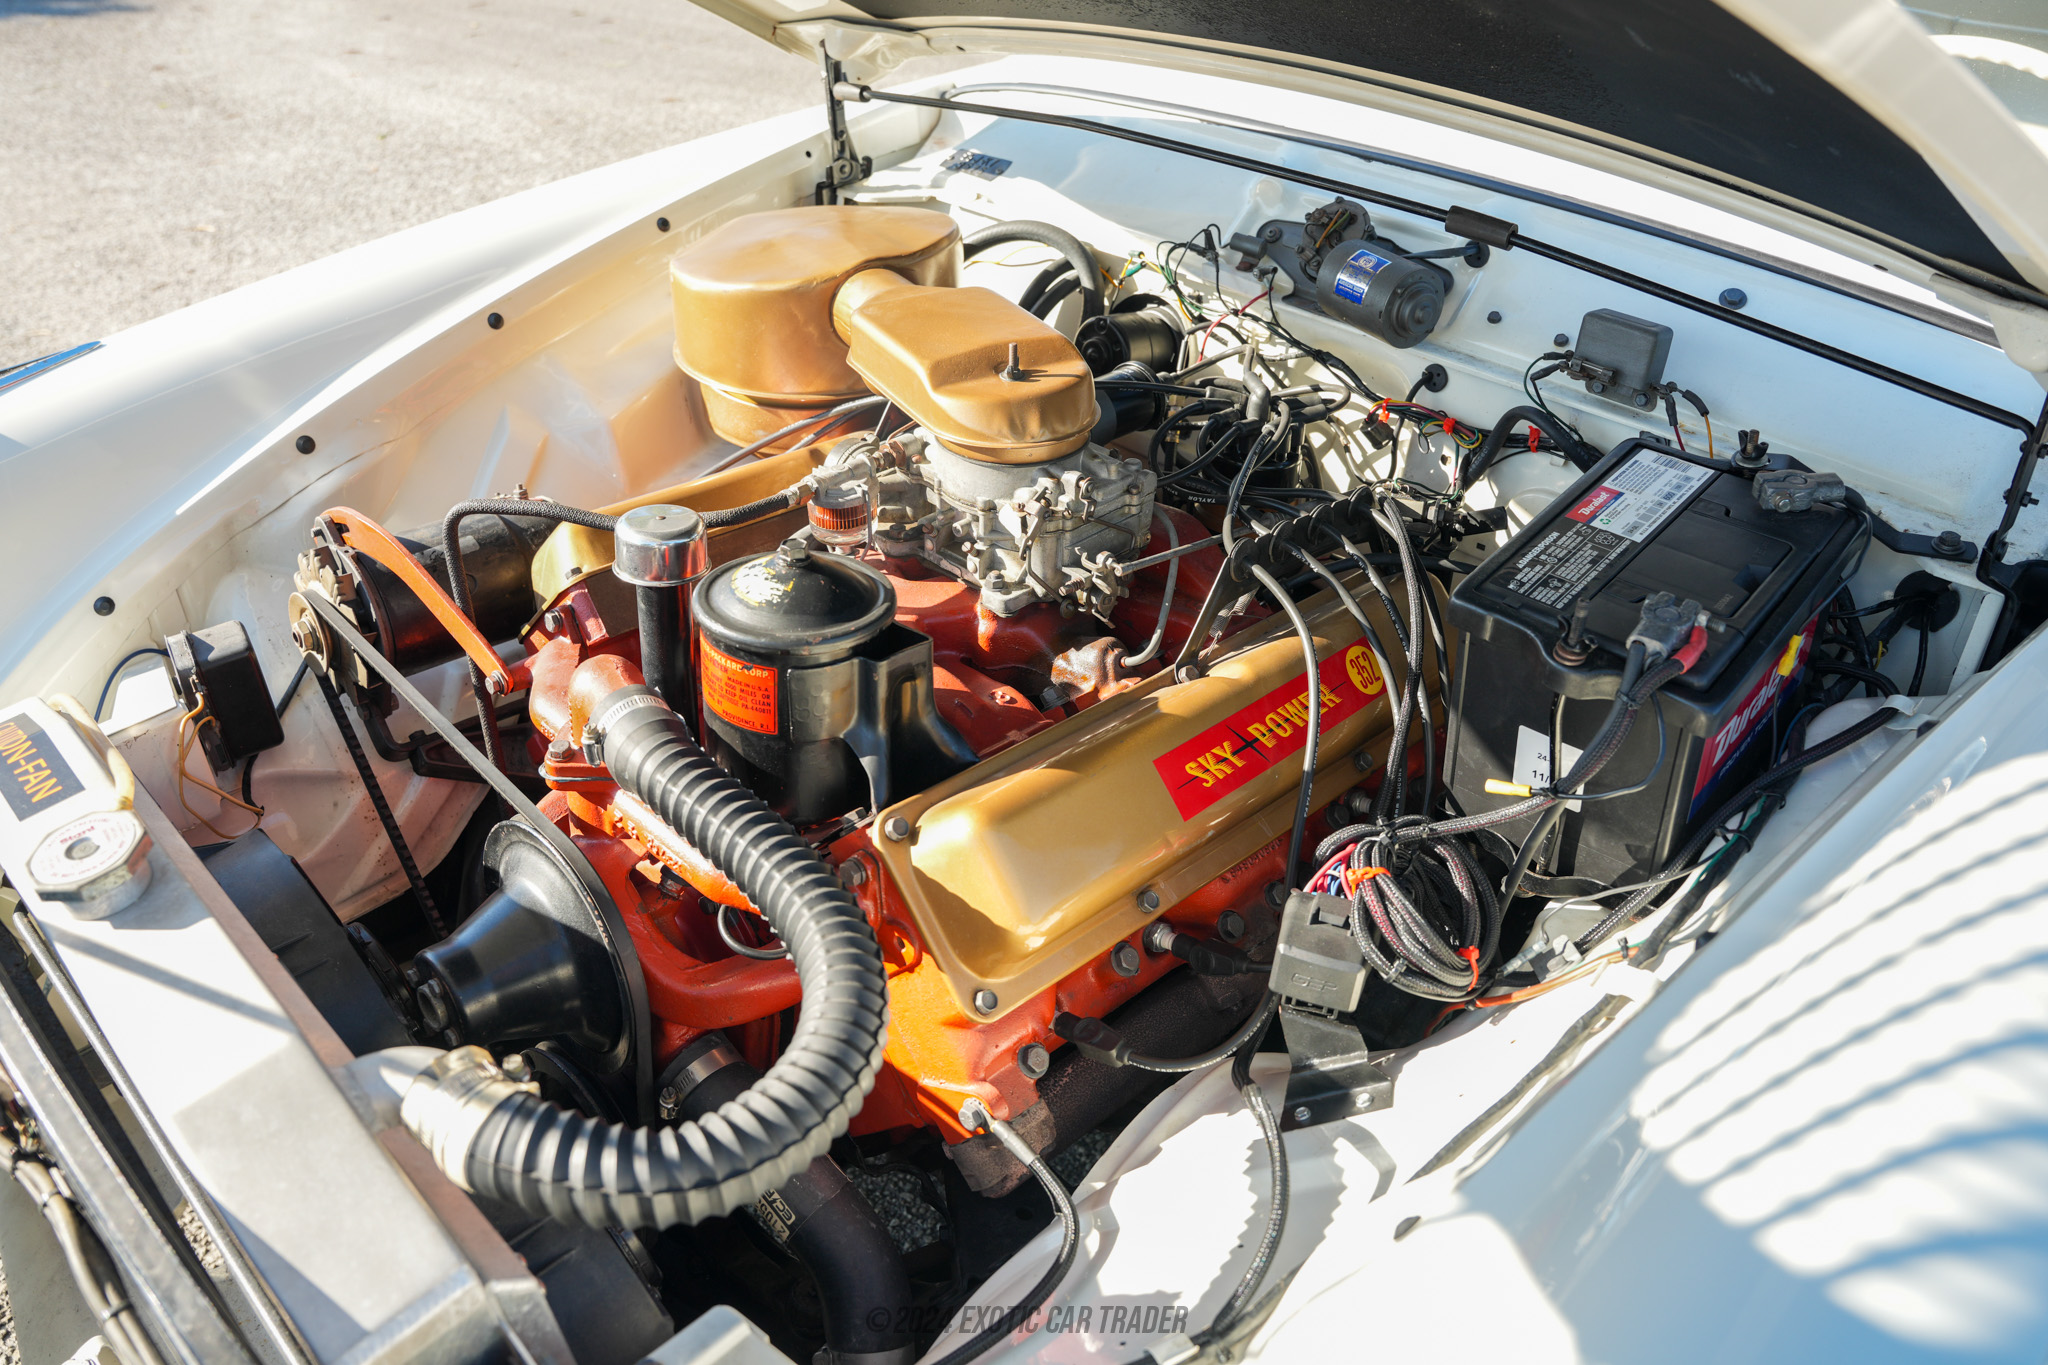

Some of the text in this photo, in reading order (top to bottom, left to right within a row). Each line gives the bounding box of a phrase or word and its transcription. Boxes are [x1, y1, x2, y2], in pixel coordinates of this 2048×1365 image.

[1578, 491, 1610, 516] Duralast
[1661, 490, 1677, 501] 600
[1349, 650, 1382, 690] 352
[740, 688, 757, 698] MILES
[751, 698, 771, 707] CLEAN
[1712, 631, 1807, 767] Duralat
[1184, 740, 1247, 788] SKY
